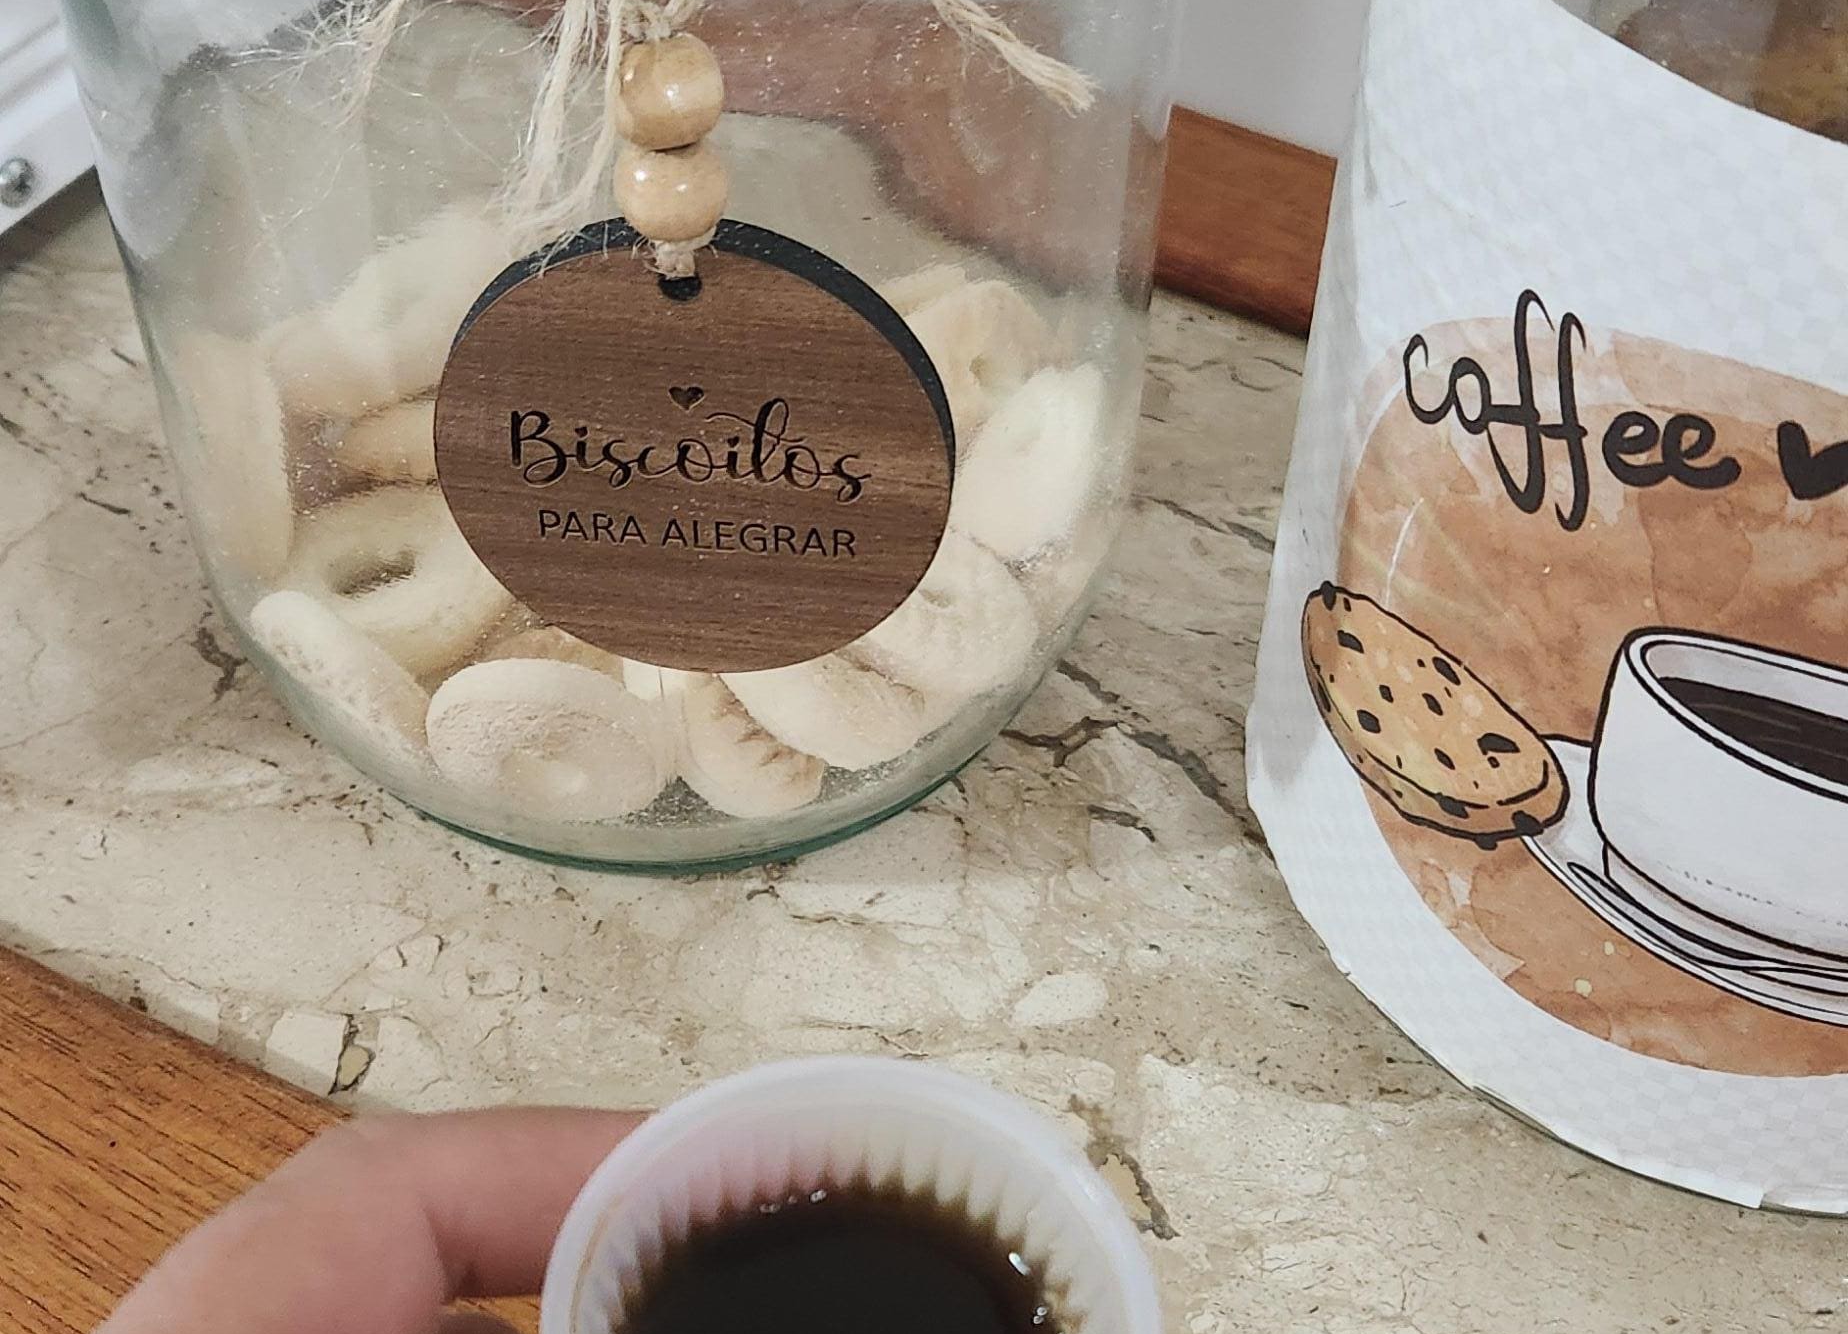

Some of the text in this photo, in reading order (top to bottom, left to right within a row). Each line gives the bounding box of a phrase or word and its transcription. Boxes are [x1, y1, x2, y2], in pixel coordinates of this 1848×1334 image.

[509, 397, 872, 503] Biscoitos
[1403, 288, 1742, 532] coffee
[538, 508, 858, 558] PARA ALEGRAR
